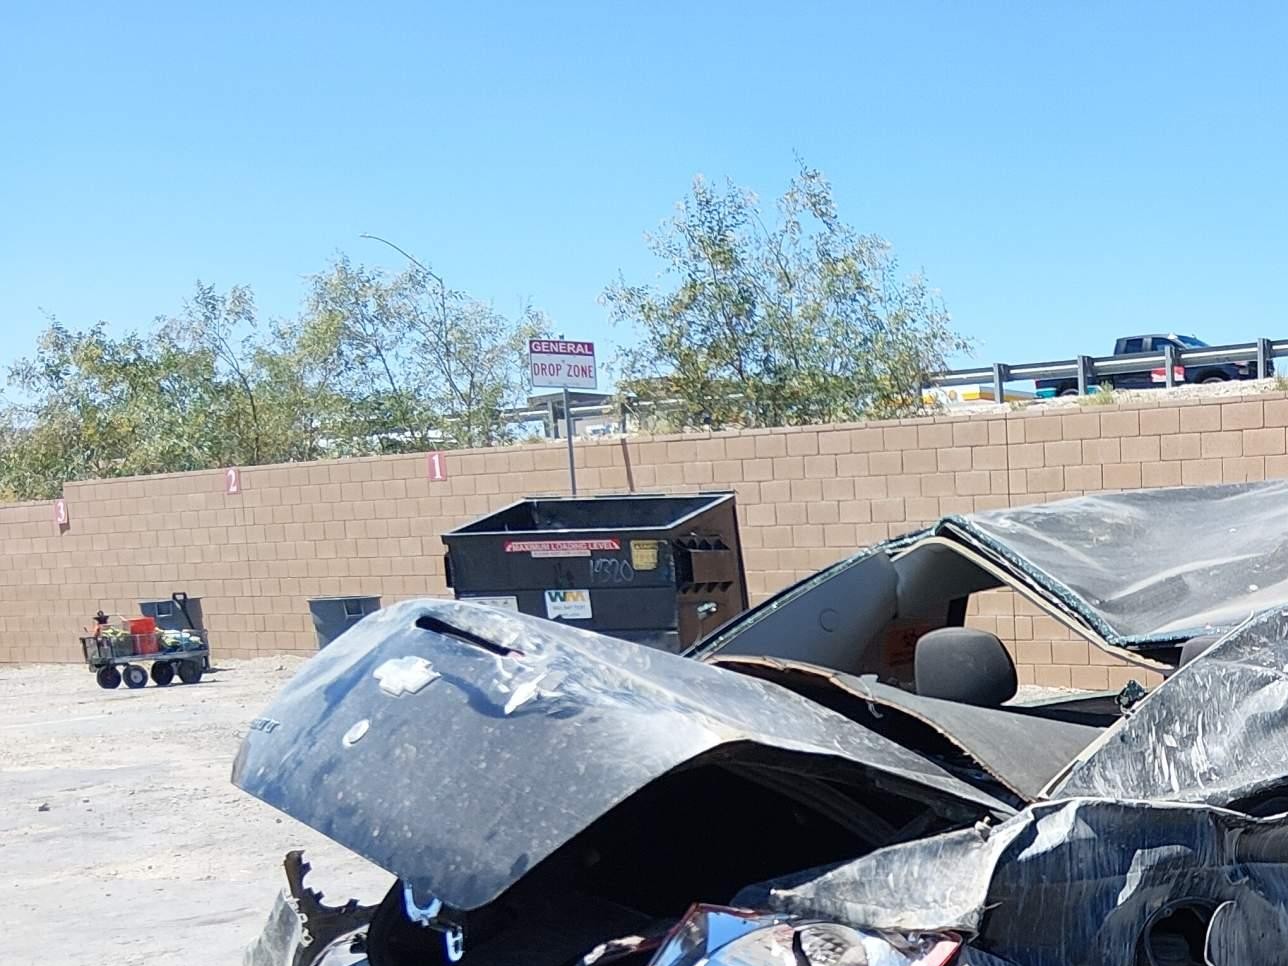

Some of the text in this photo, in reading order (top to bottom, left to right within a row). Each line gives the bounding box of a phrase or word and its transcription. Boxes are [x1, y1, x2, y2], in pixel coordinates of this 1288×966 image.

[531, 341, 593, 354] GENERAL
[533, 362, 594, 379] DROP ZONE
[432, 454, 442, 479] 1
[227, 469, 237, 492] 2
[57, 501, 65, 522] 3
[512, 541, 616, 552] MAXIMUM LOADING LEVEL
[548, 591, 586, 602] WM
